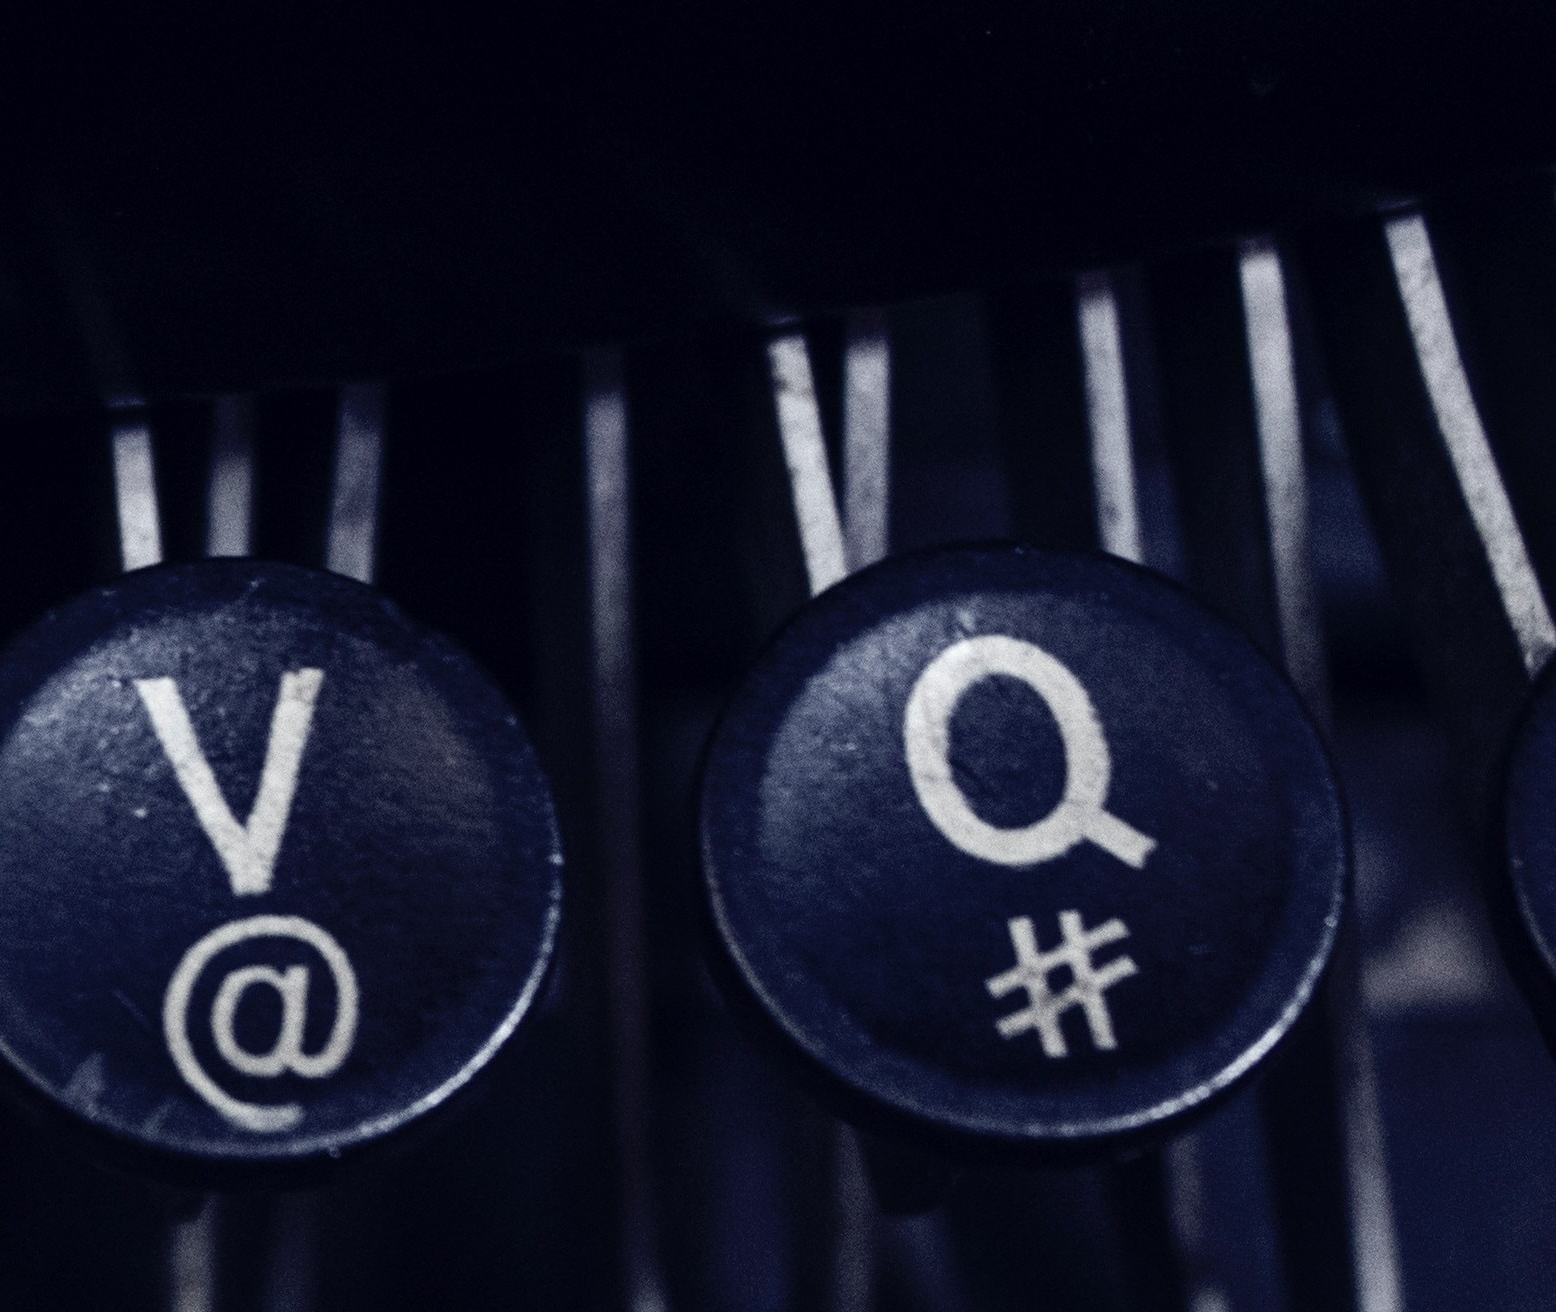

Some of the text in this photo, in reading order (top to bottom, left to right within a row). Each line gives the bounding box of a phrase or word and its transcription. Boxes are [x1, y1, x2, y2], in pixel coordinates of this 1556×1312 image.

[132, 666, 324, 894] V
[903, 634, 1156, 870] Q
[162, 913, 359, 1132] @
[985, 910, 1140, 1057] #
